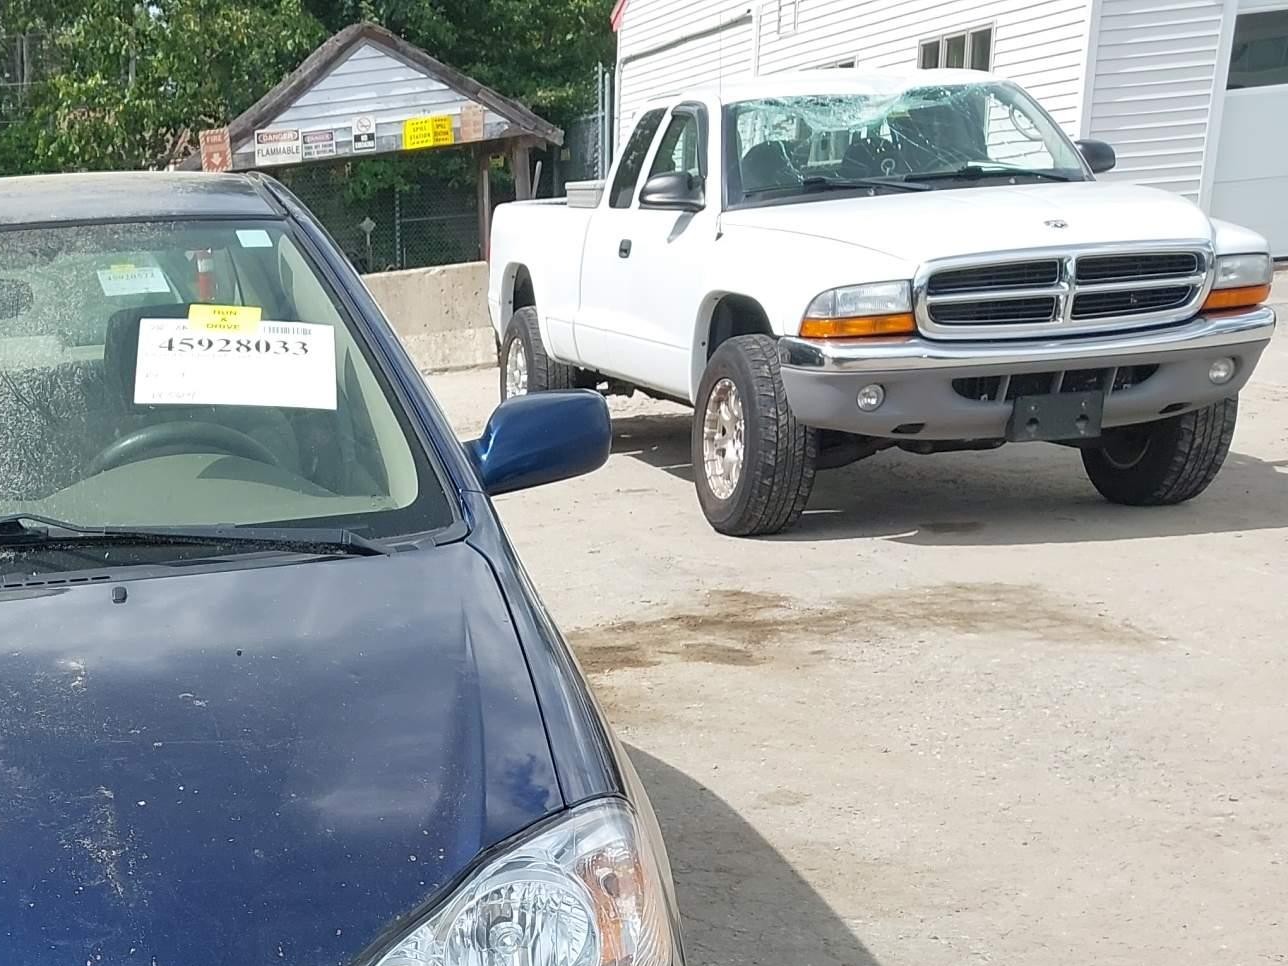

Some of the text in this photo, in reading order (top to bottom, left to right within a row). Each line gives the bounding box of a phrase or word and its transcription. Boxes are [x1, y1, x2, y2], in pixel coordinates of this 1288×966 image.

[206, 134, 223, 143] FIRE
[261, 132, 295, 142] DANGER
[257, 145, 300, 158] FLAMMABLE
[158, 337, 310, 356] 45928033
